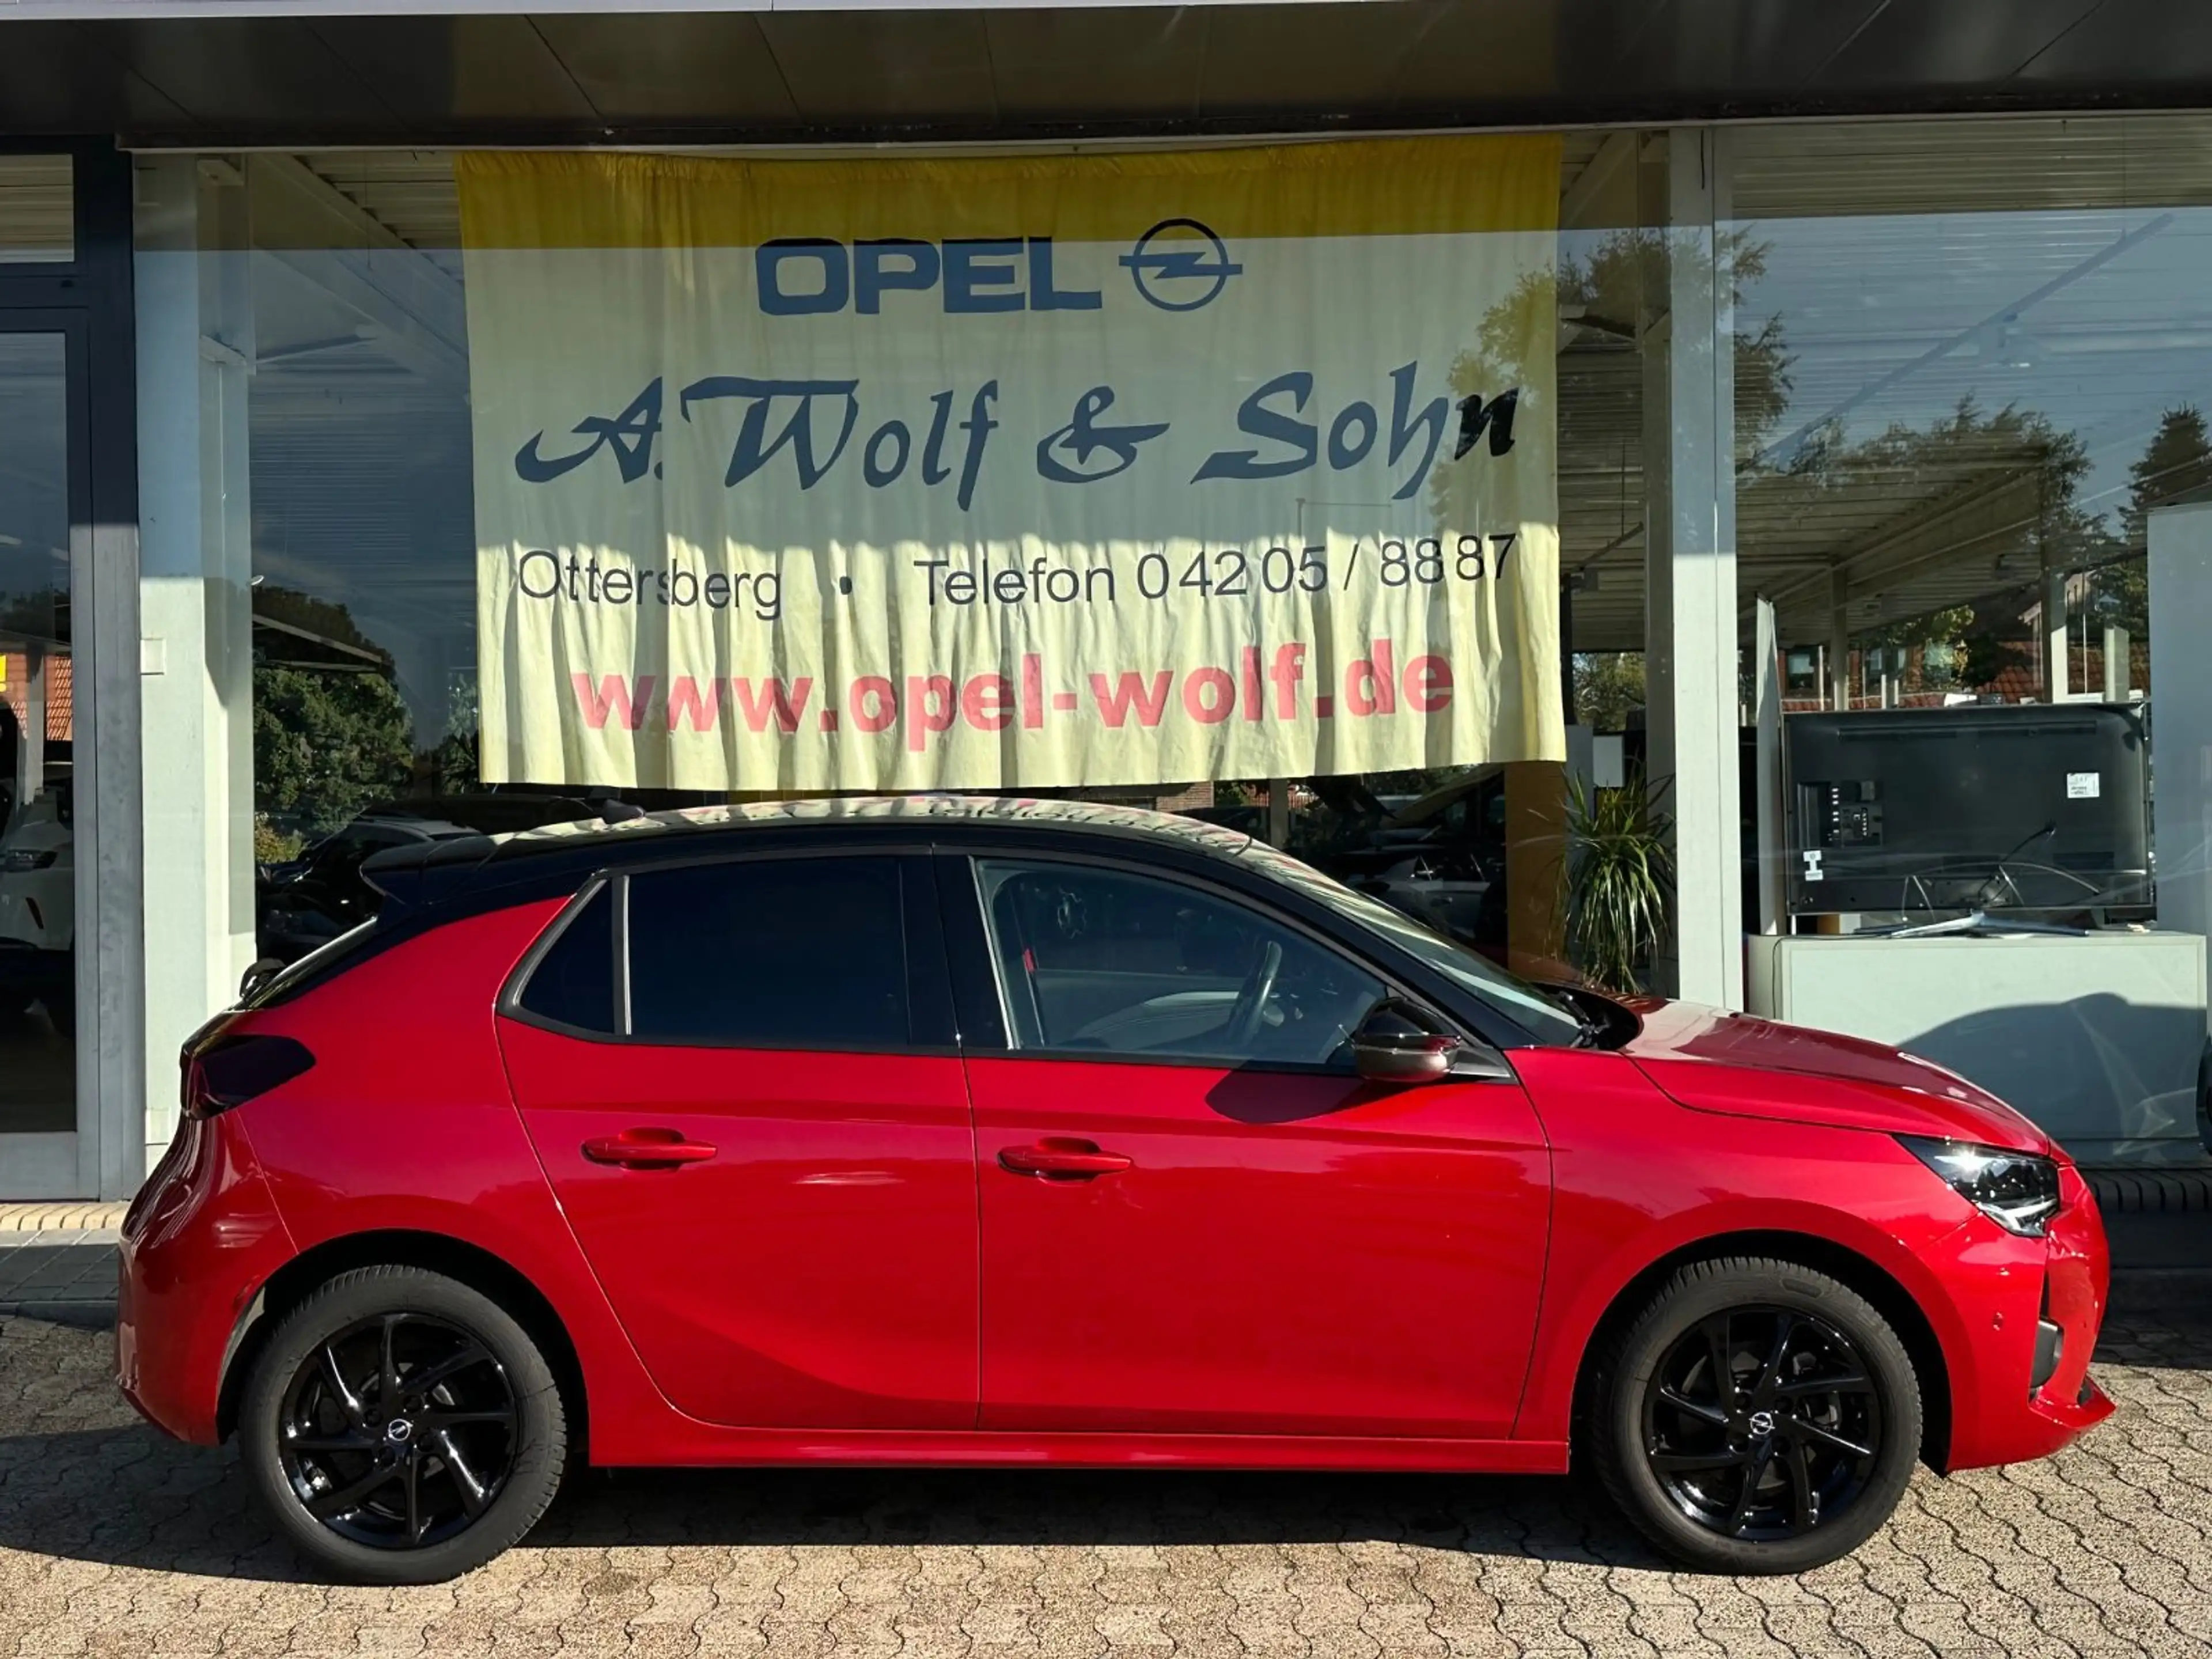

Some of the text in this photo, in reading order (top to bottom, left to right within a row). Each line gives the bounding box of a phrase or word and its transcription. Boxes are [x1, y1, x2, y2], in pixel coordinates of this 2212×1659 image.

[755, 236, 1103, 316] OPEL
[1036, 385, 1171, 483] &
[1190, 361, 1519, 500] Sohn
[518, 550, 782, 621] Ottersberg
[913, 556, 1115, 605] Telefon
[571, 638, 1454, 752] www.opel-wolf.de
